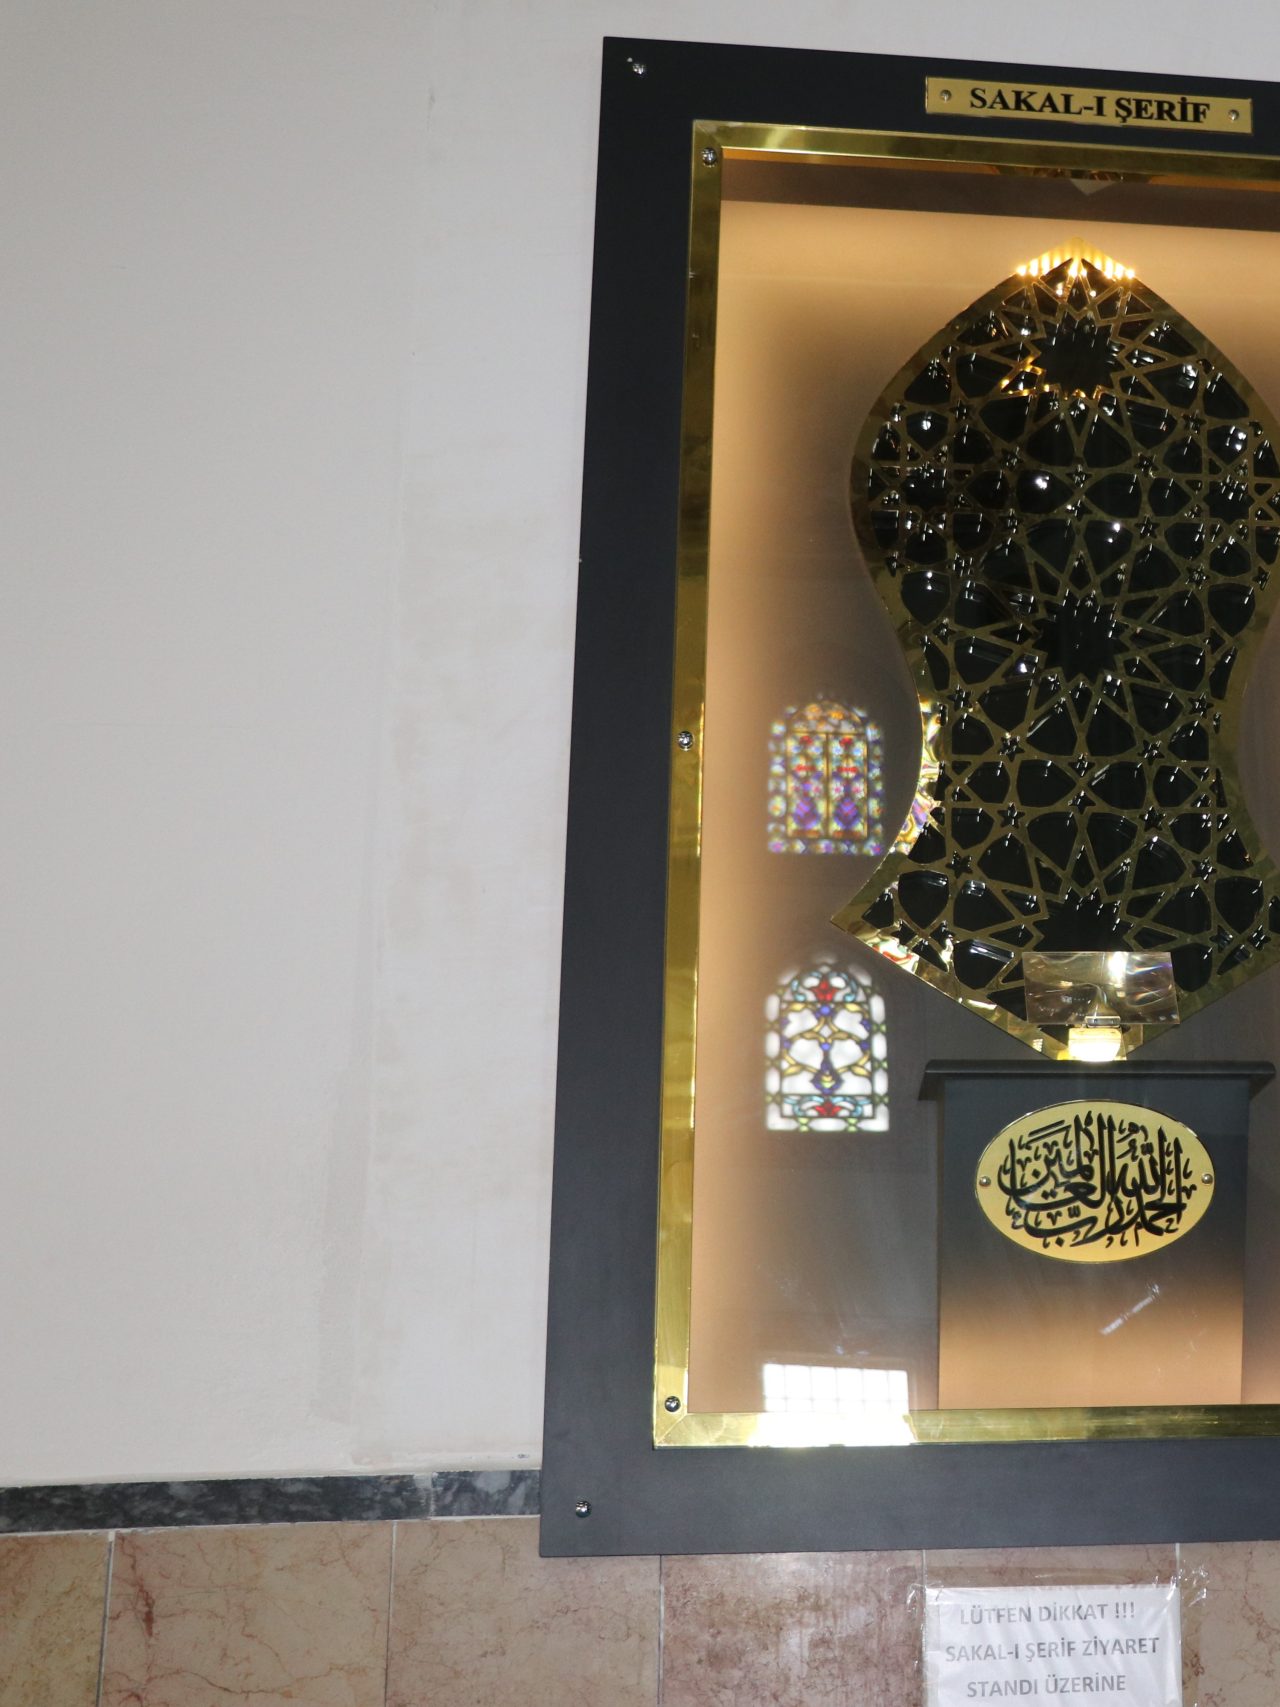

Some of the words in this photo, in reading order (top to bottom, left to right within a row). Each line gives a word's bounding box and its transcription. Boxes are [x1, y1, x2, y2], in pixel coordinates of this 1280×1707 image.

[969, 87, 1107, 117] SAKAL-I
[1114, 96, 1211, 123] ŞERİF
[960, 1603, 1032, 1625] LÜTFEN
[1038, 1602, 1108, 1622] DİKKAT
[1115, 1602, 1135, 1618] !!!
[945, 1642, 1019, 1662] SAKAL-I
[1025, 1637, 1076, 1662] ŞERİF
[1082, 1635, 1160, 1656] ZİYARET
[967, 1679, 1038, 1698] STANDI
[1045, 1673, 1126, 1694] ÜZERİNE
